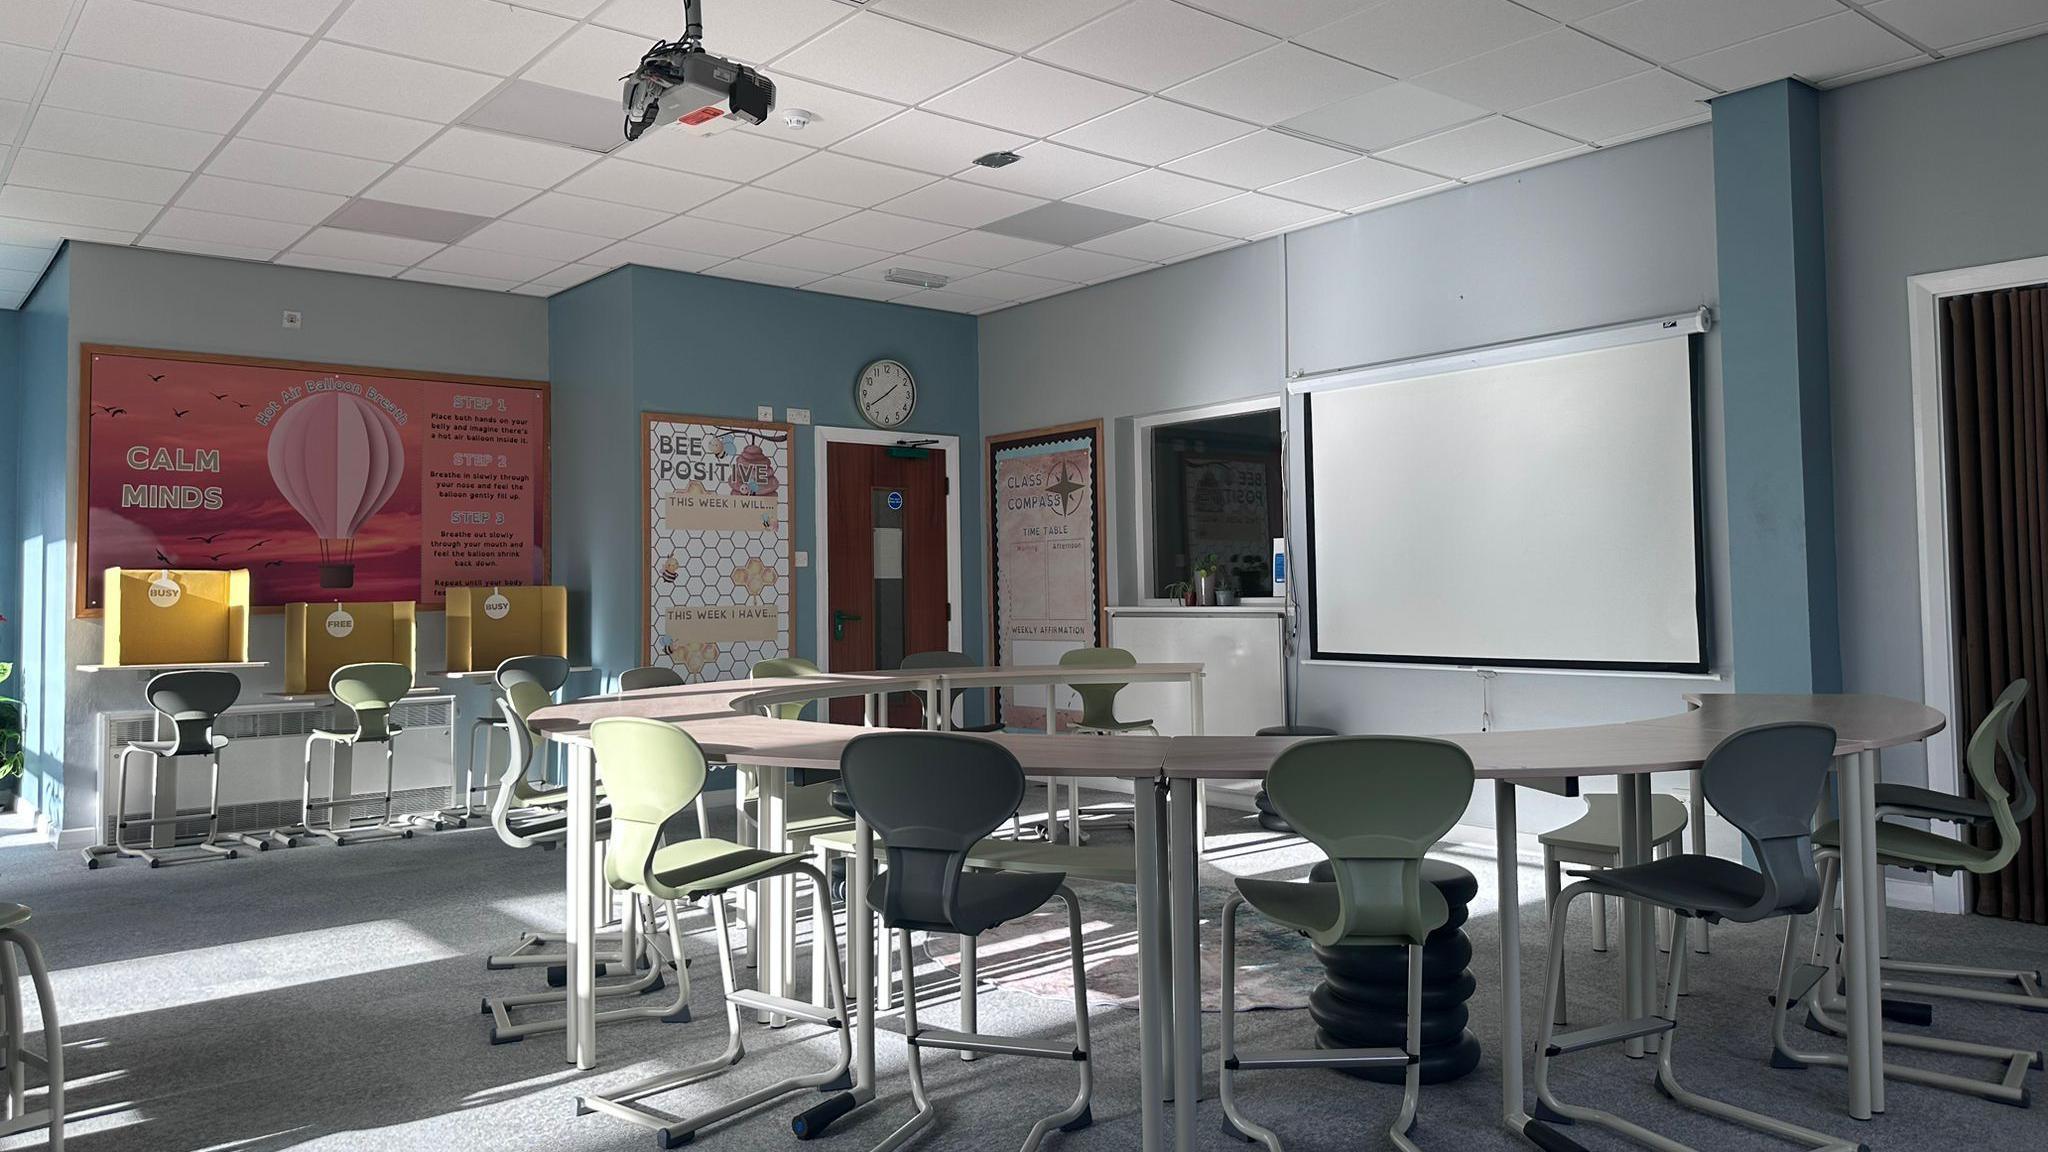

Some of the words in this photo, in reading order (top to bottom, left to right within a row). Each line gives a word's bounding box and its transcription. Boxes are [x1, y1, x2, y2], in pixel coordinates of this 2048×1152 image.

[874, 368, 880, 378] 11
[884, 364, 890, 374] 12
[866, 376, 873, 386] 10
[902, 378, 908, 386] 2
[863, 390, 868, 398] 9
[906, 390, 911, 400] 3
[256, 400, 282, 426] Hot
[281, 386, 302, 402] Air
[305, 378, 362, 394] Balloon
[366, 385, 408, 426] Breath
[453, 395, 492, 410] STEP
[498, 398, 506, 412] 1
[866, 402, 871, 411] 8
[875, 411, 880, 420] 7
[884, 415, 890, 424] 6
[896, 412, 900, 420] 5
[432, 423, 450, 431] belly
[660, 435, 702, 456] BEE
[126, 446, 220, 472] CALM
[453, 452, 493, 466] STEP
[498, 455, 507, 468] 2
[473, 472, 497, 480] slowly
[500, 473, 530, 482] through
[660, 460, 768, 484] POSITIVE
[1007, 474, 1042, 489] CLASS
[122, 484, 224, 510] MINDS
[470, 491, 494, 500] gently
[670, 496, 694, 506] THIS
[700, 499, 728, 508] WEEK
[741, 500, 774, 510] WILL...
[1007, 494, 1060, 510] COMPASS
[451, 510, 490, 524] STEP
[496, 512, 505, 525] 3
[489, 531, 513, 539] slowly
[1023, 528, 1040, 536] TIME
[1043, 525, 1068, 535] TABLE
[150, 589, 179, 597] BUSY
[668, 610, 692, 620] THIS
[697, 610, 727, 619] WEEK
[739, 609, 777, 618] HAVE...
[328, 620, 352, 628] FREE
[1012, 626, 1038, 634] WEEKLY
[1040, 626, 1085, 634] AFFIRMATION
